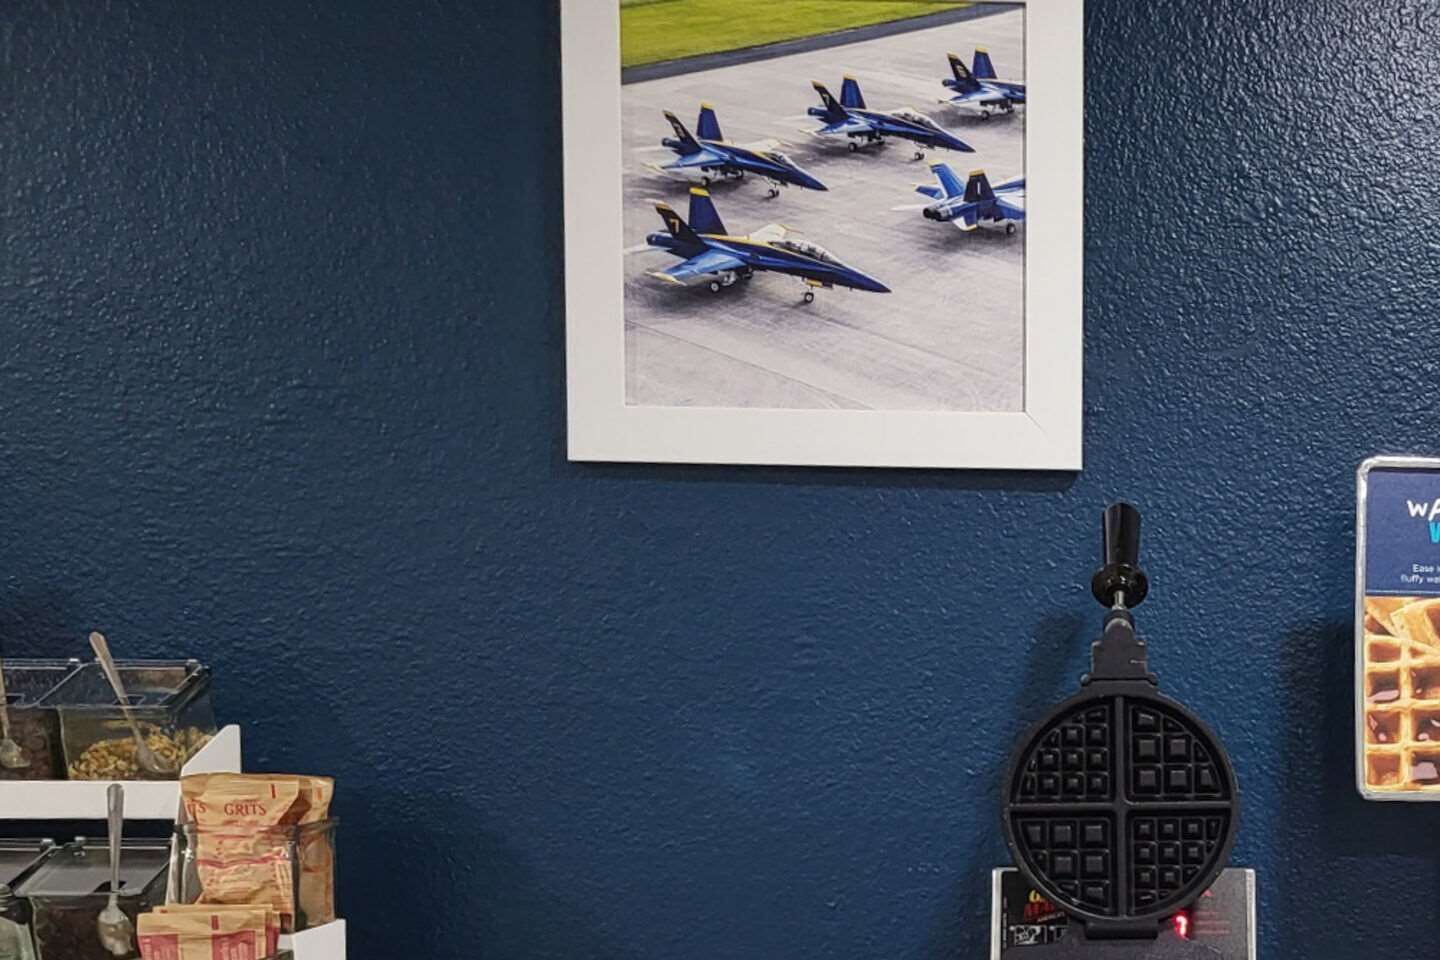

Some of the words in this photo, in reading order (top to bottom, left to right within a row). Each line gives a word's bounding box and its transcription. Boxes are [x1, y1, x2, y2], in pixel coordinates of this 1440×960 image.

[1412, 563, 1435, 574] Ease
[1400, 573, 1425, 585] fluffy
[224, 800, 267, 817] GRITS
